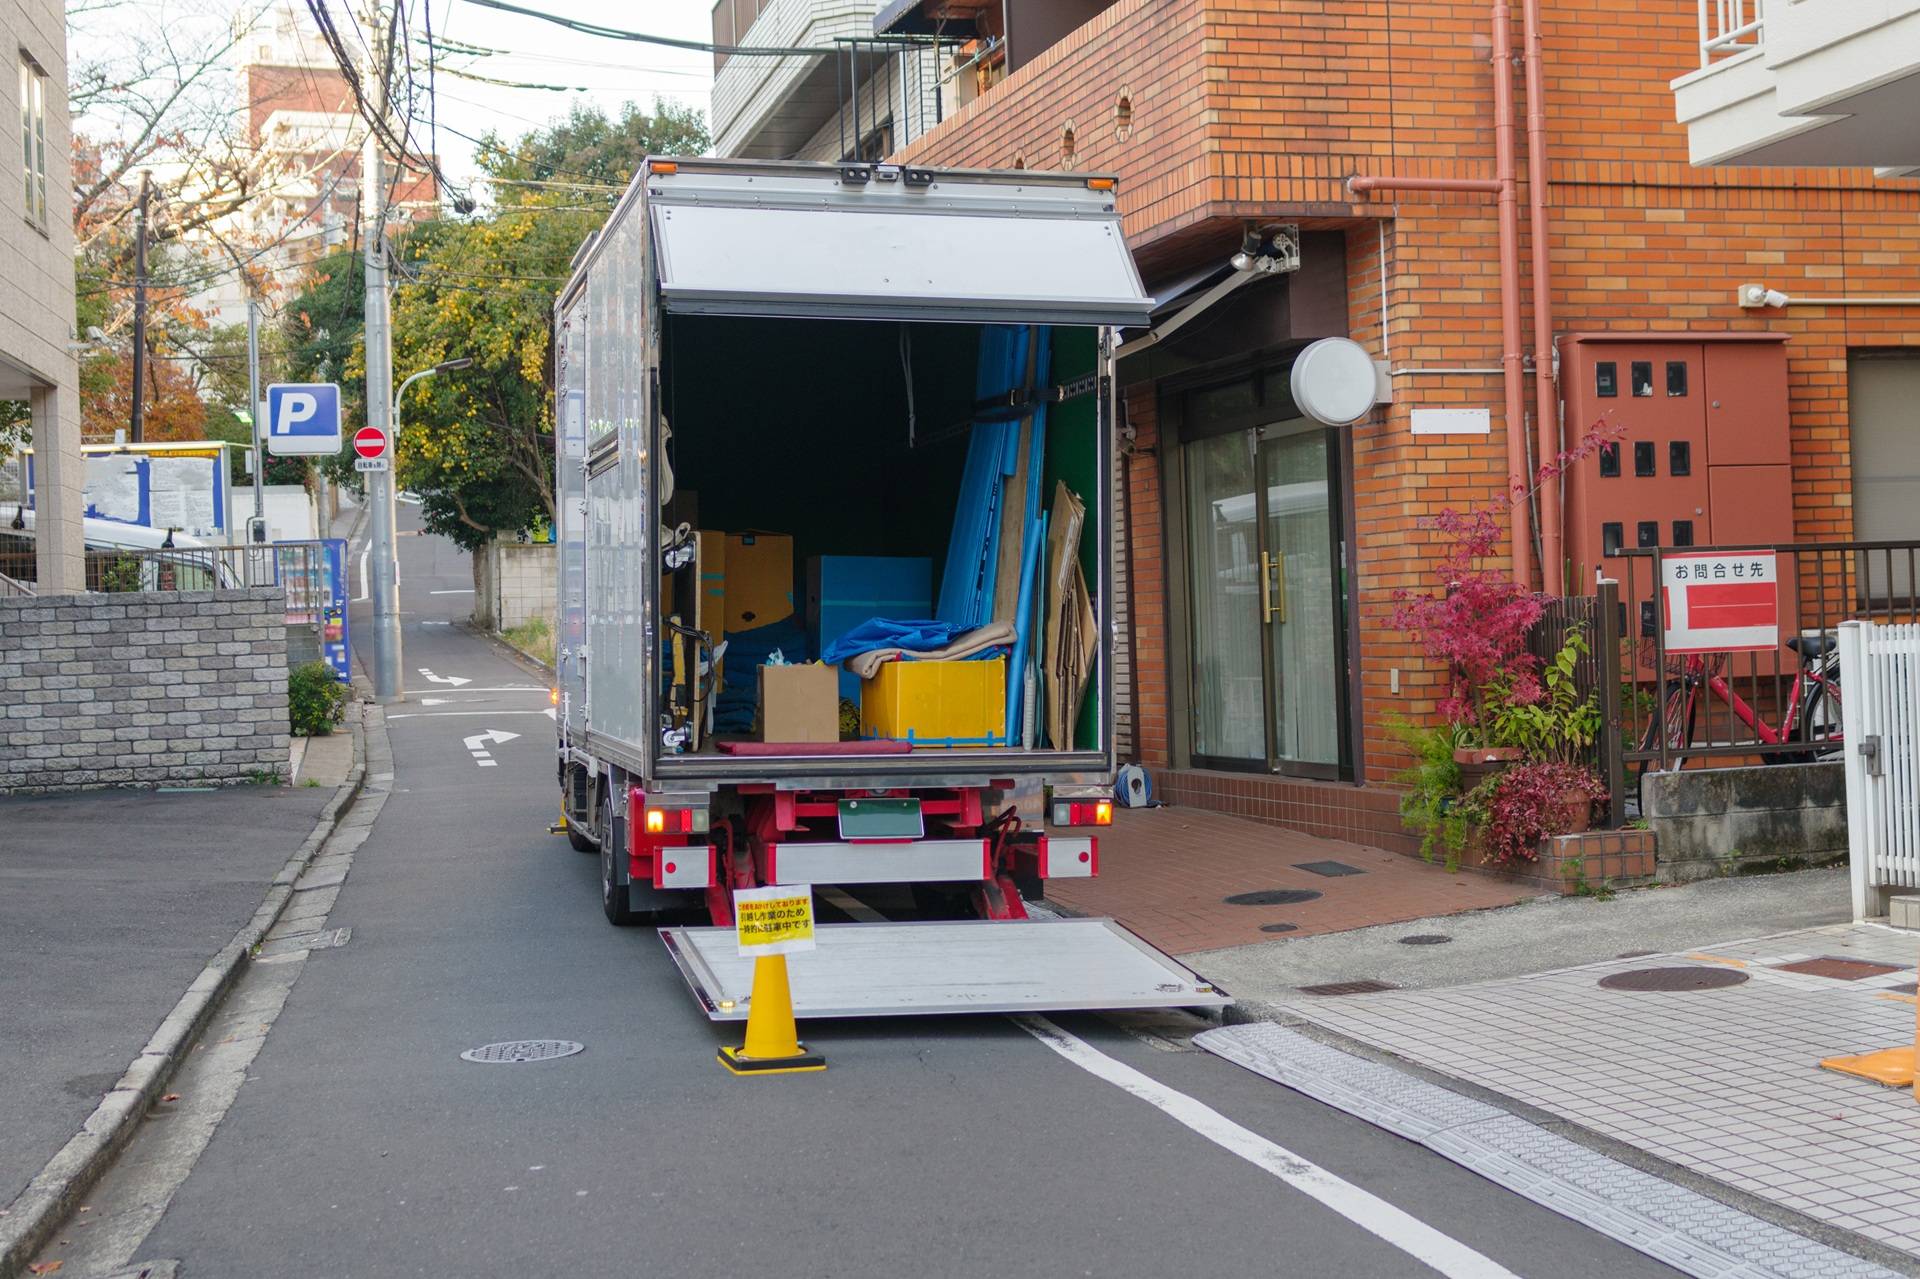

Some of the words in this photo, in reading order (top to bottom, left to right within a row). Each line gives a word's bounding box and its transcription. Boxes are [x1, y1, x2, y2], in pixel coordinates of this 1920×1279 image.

[276, 392, 317, 434] P
[1675, 562, 1763, 579] お問合せ先
[741, 908, 805, 921] 引越し作業のため
[739, 919, 810, 933] 一時的に駐車中です
